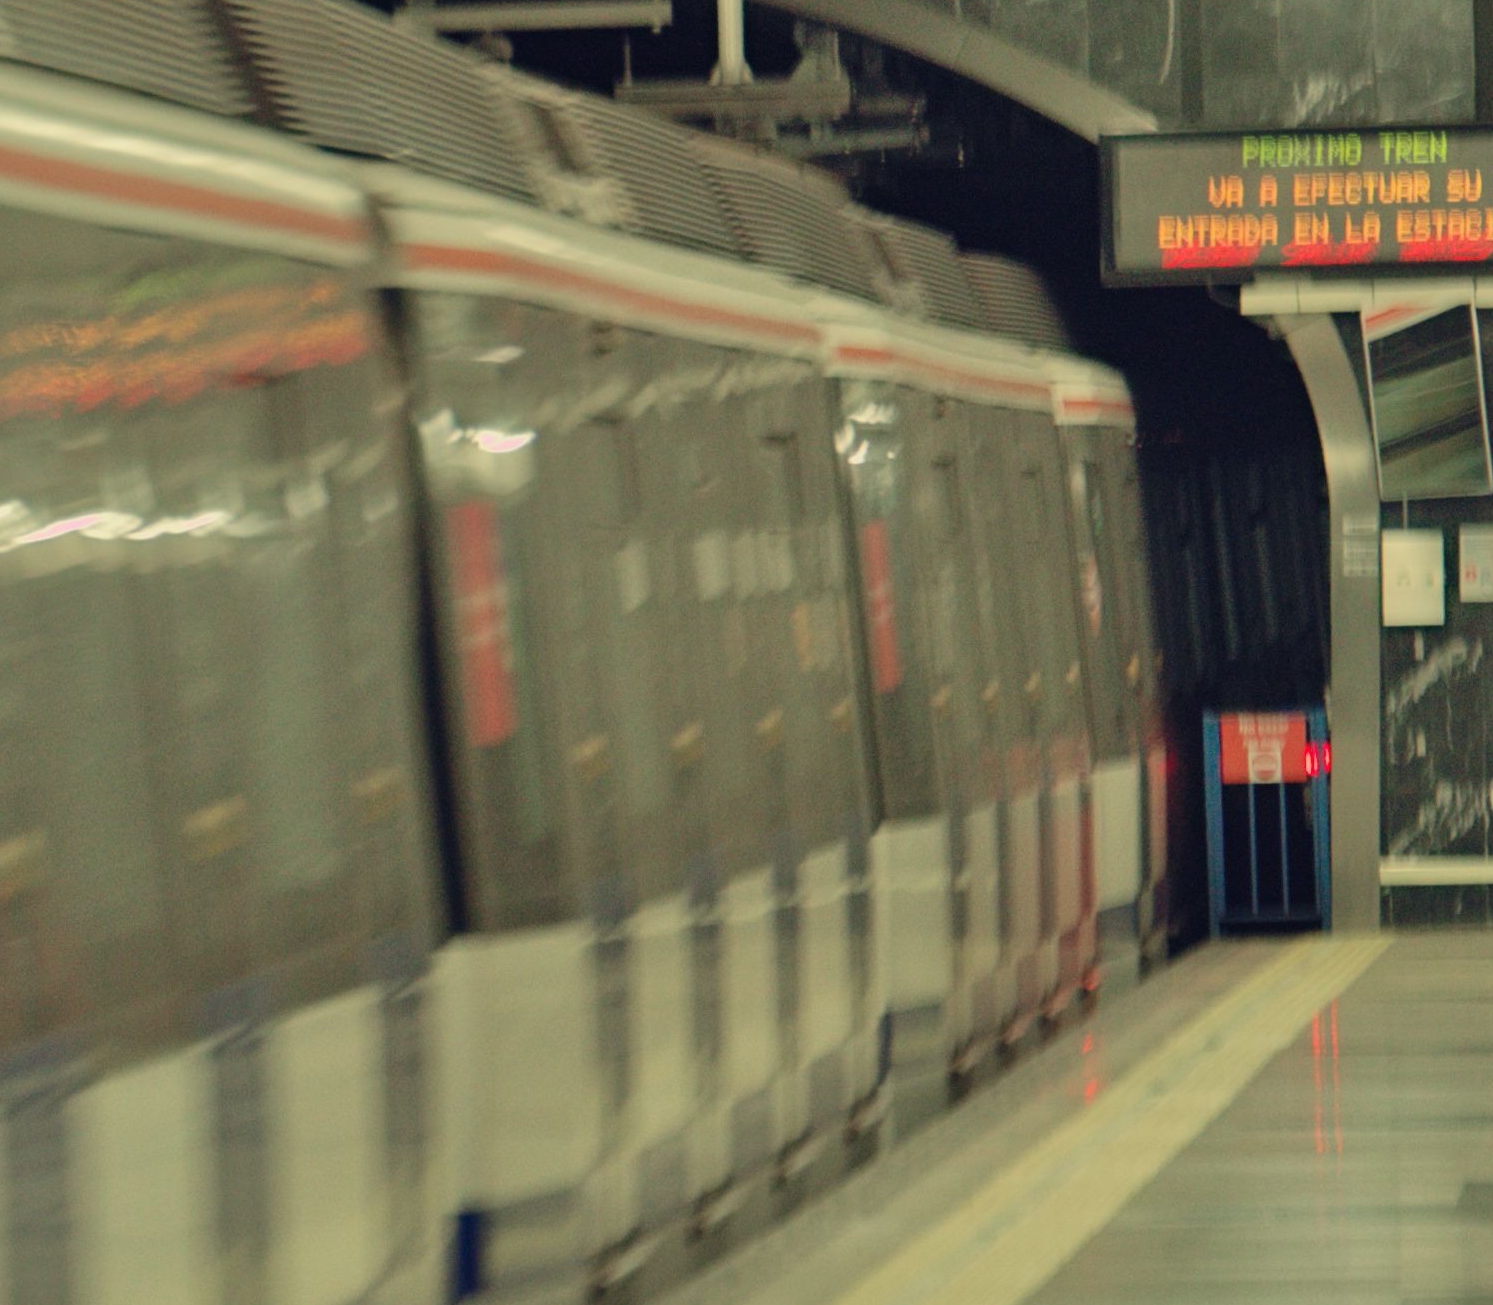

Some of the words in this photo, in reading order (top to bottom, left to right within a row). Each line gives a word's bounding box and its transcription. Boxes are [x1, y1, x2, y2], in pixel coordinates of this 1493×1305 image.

[1242, 133, 1362, 167] PROXIMO
[1379, 131, 1447, 164] TREN
[1209, 174, 1244, 208] VA
[1259, 174, 1277, 207] A
[1294, 170, 1430, 206] EFECTUAR
[1447, 169, 1482, 203] SU
[1159, 213, 1278, 249] ENTRADA
[1294, 211, 1329, 246] EN
[1345, 210, 1380, 244] LA
